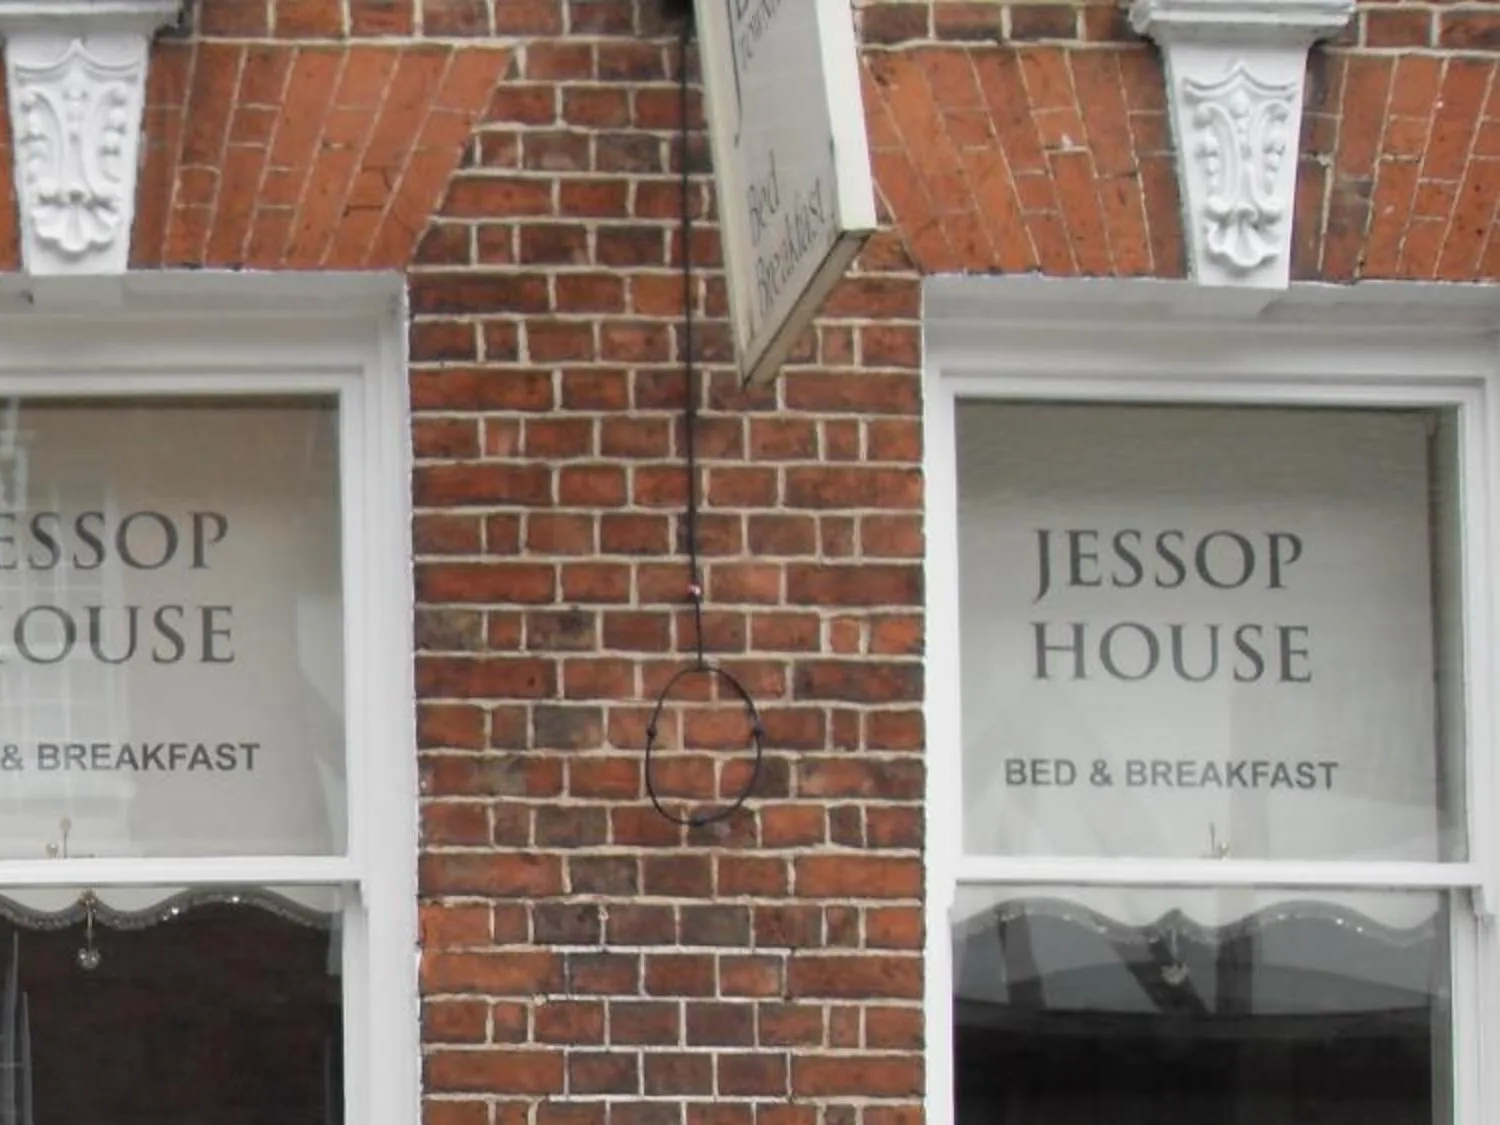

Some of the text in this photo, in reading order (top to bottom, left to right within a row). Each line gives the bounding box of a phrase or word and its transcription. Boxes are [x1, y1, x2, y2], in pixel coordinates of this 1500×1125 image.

[1032, 528, 1303, 604] JESSOP
[1030, 621, 1313, 683] HOUSE
[0, 744, 25, 771] &
[38, 743, 261, 771] BREAKFAST
[1004, 759, 1339, 790] BED & BREAKFAST
